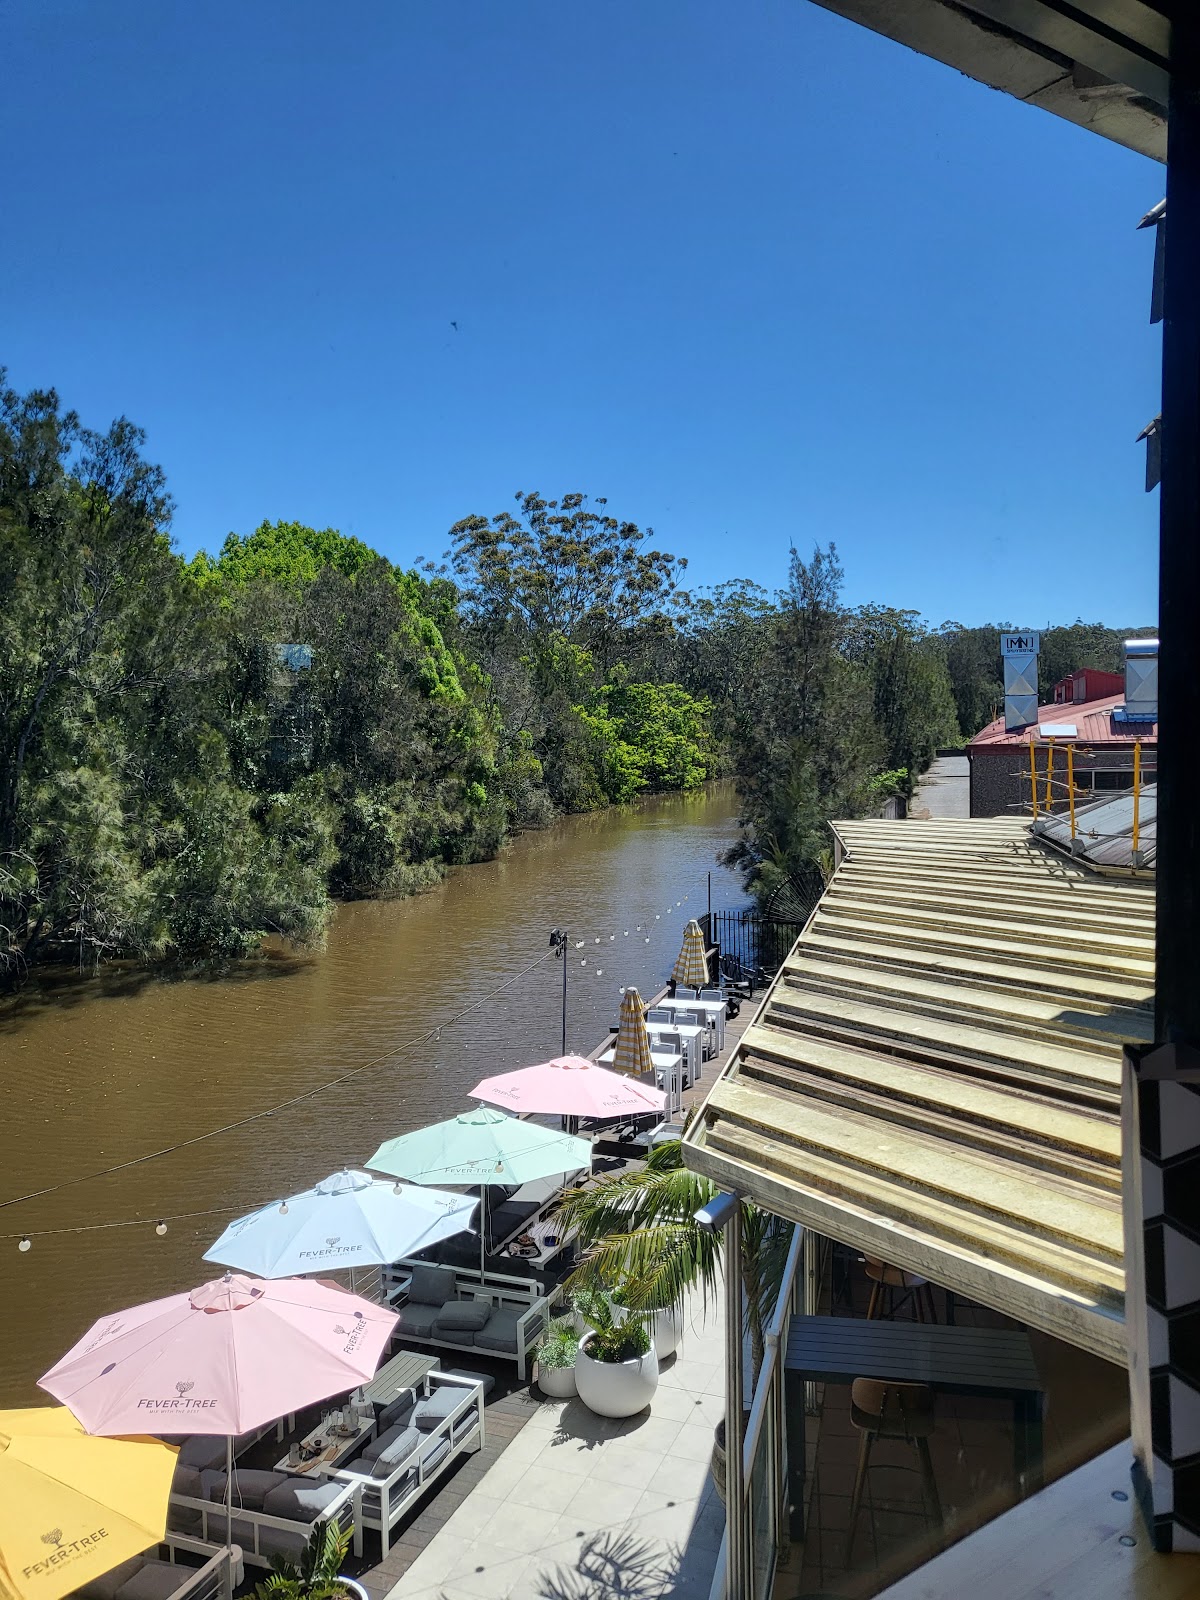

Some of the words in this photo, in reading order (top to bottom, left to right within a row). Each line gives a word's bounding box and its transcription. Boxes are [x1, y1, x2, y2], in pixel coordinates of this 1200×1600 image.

[299, 1245, 363, 1259] FEVER-TREE
[343, 1319, 367, 1355] FEVER-TREE
[137, 1399, 218, 1408] FEVER-TREE
[22, 1528, 109, 1580] FEVER-TREE
